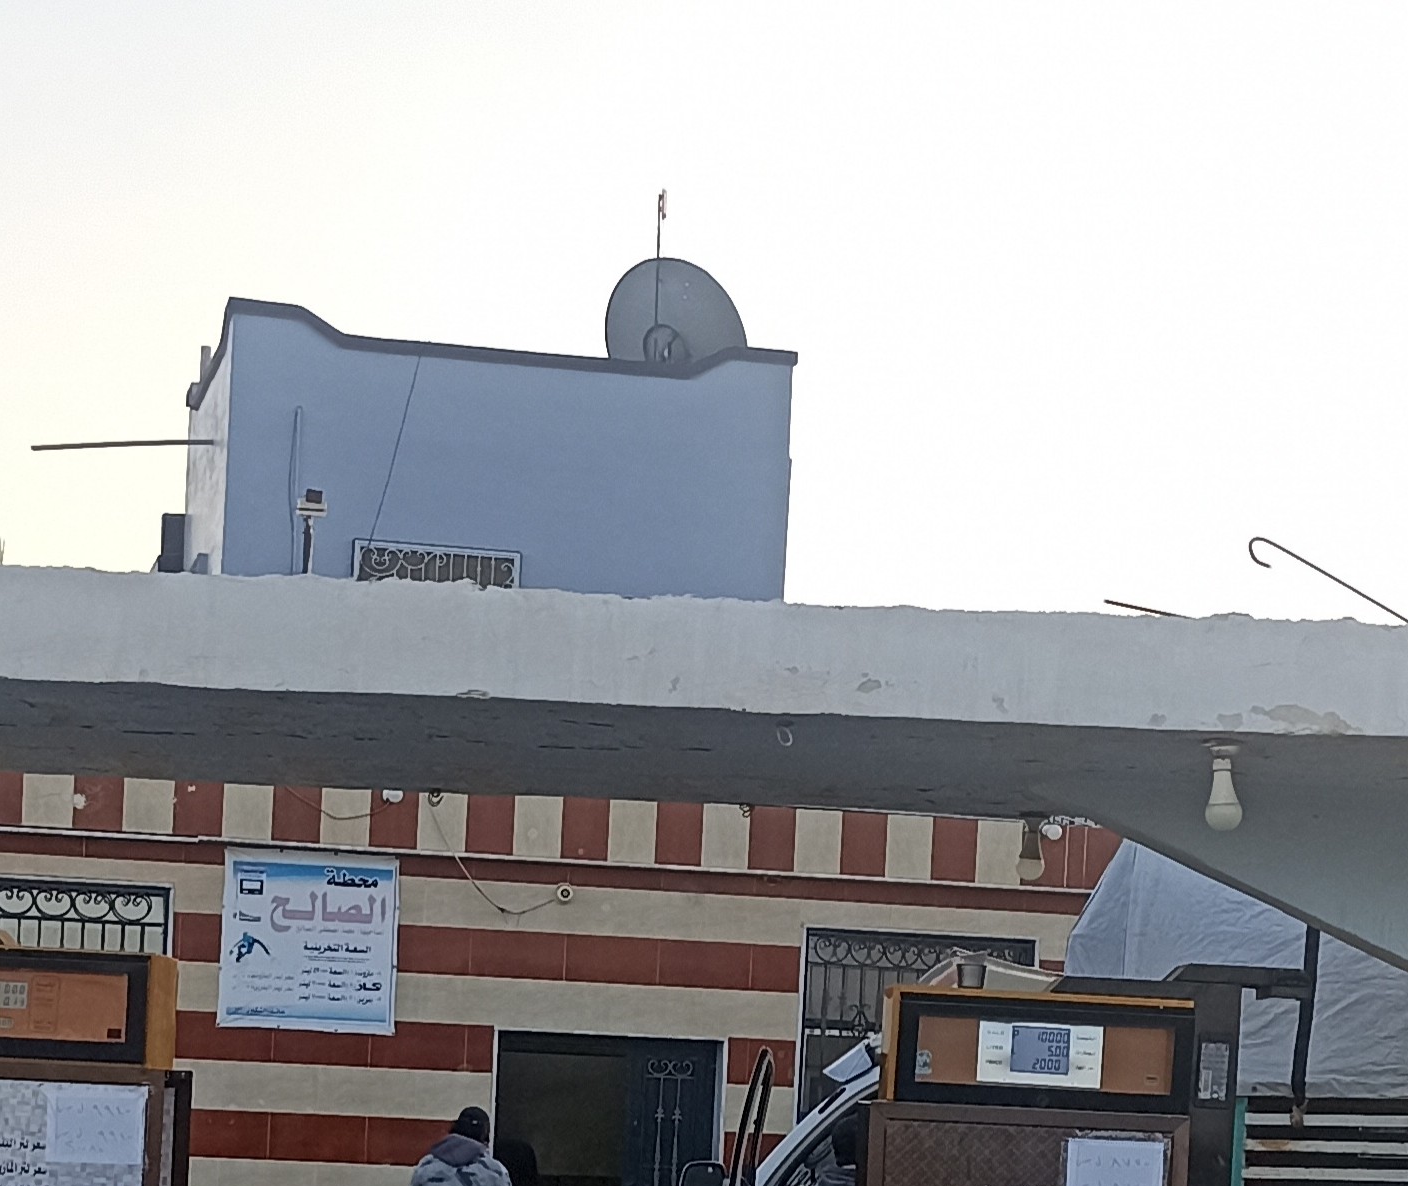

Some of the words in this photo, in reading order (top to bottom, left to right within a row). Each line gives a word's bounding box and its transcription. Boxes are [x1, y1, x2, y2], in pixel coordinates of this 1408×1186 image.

[326, 868, 379, 888] محطة
[270, 890, 387, 933] الصالح
[345, 942, 372, 954] السعة
[1032, 1058, 1061, 1071] 2000
